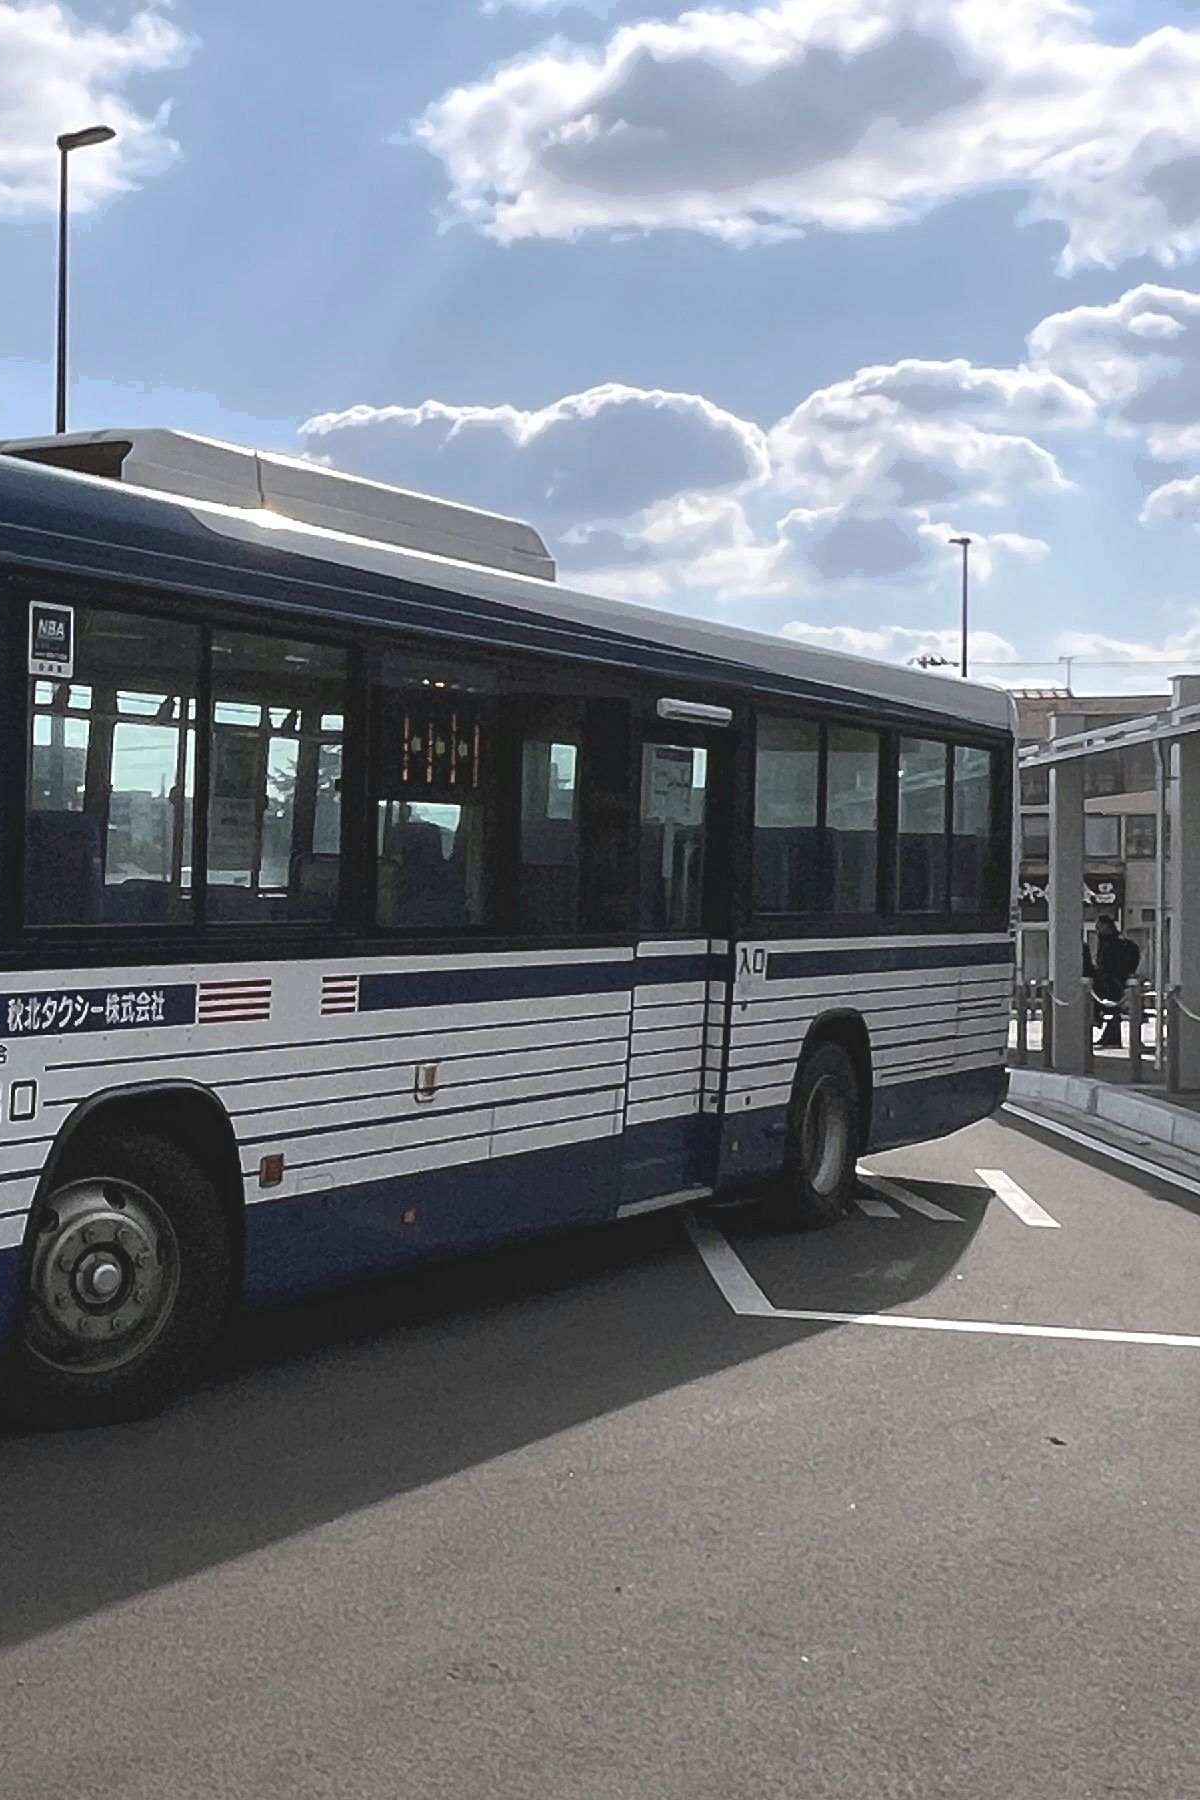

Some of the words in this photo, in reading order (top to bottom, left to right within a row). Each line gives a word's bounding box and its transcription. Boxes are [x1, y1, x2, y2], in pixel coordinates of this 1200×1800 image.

[739, 947, 766, 975] 入口
[6, 990, 166, 1032] 秋北タクシー株式会社
